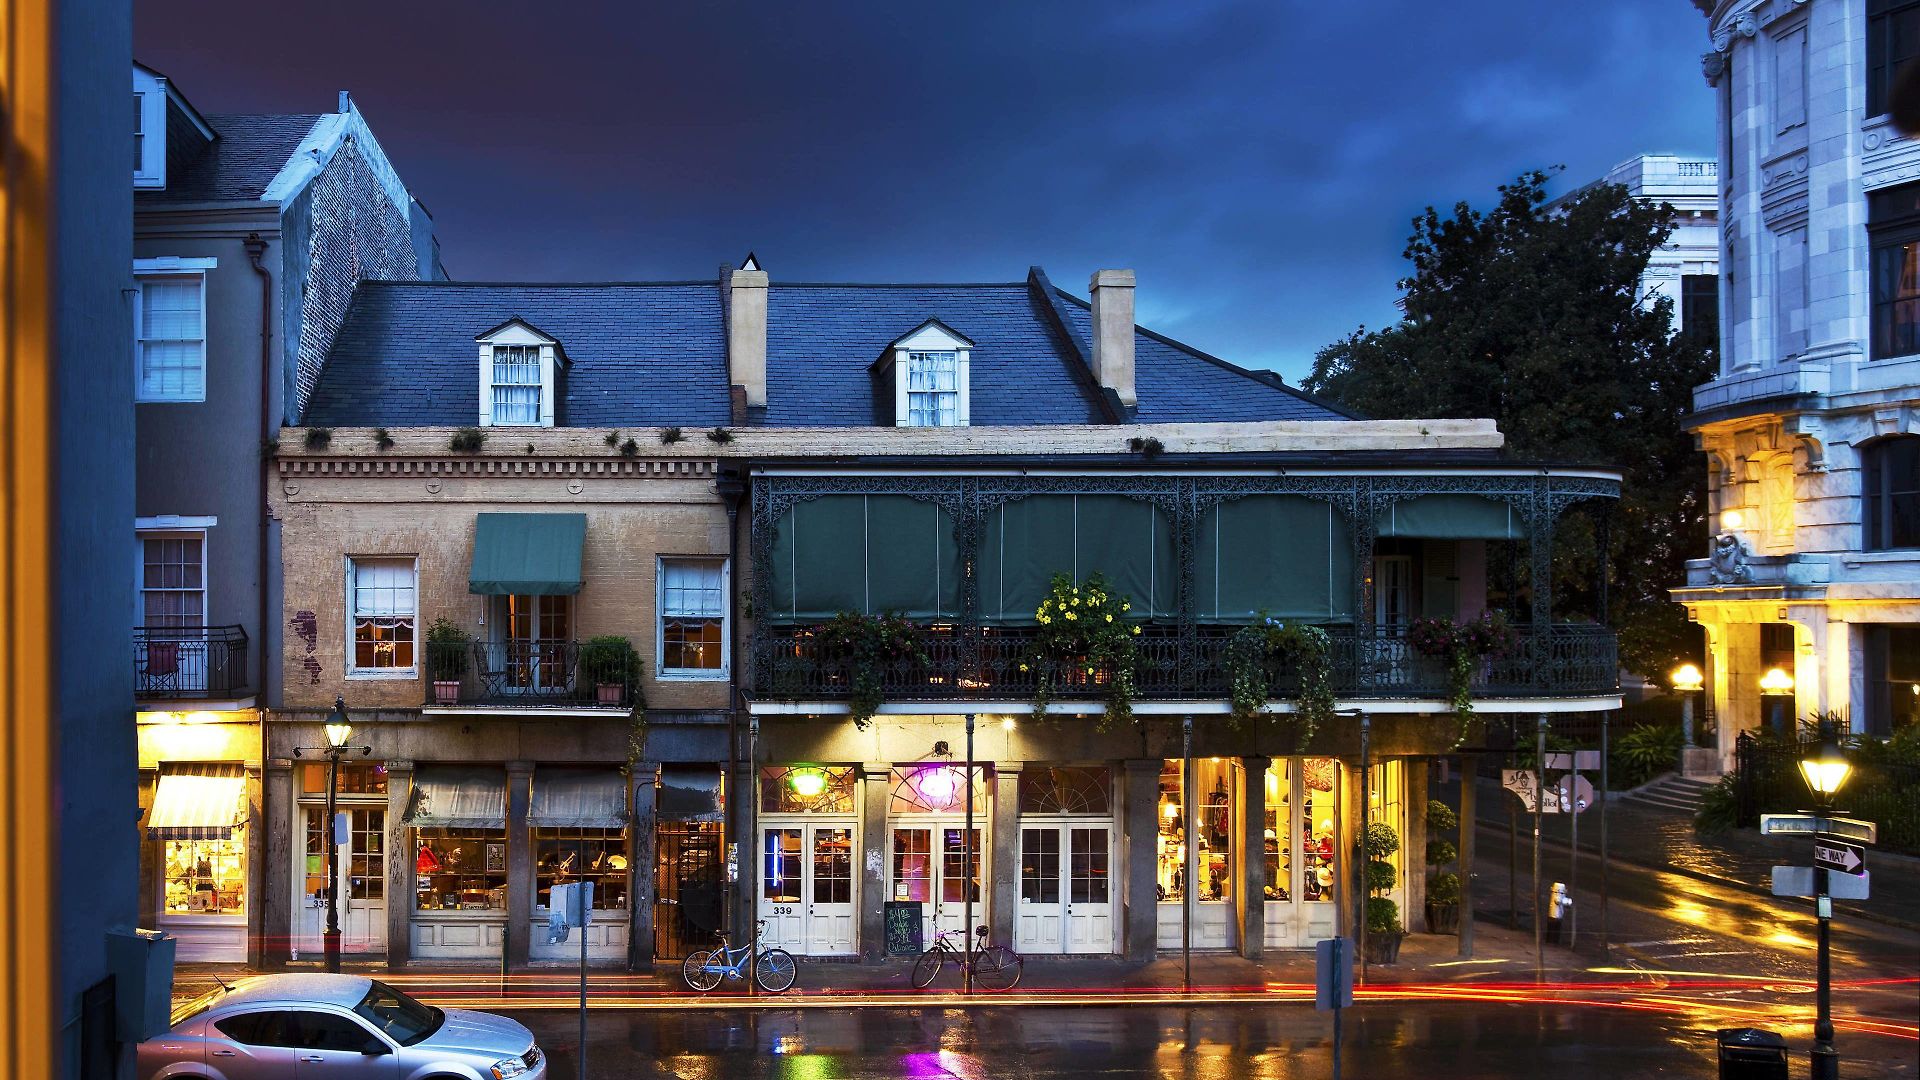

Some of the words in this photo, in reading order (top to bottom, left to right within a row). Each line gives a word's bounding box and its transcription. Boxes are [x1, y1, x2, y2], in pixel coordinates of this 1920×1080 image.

[1815, 847, 1826, 859] NE
[1828, 849, 1846, 863] WAY
[313, 899, 329, 909] 335
[773, 906, 792, 915] 339
